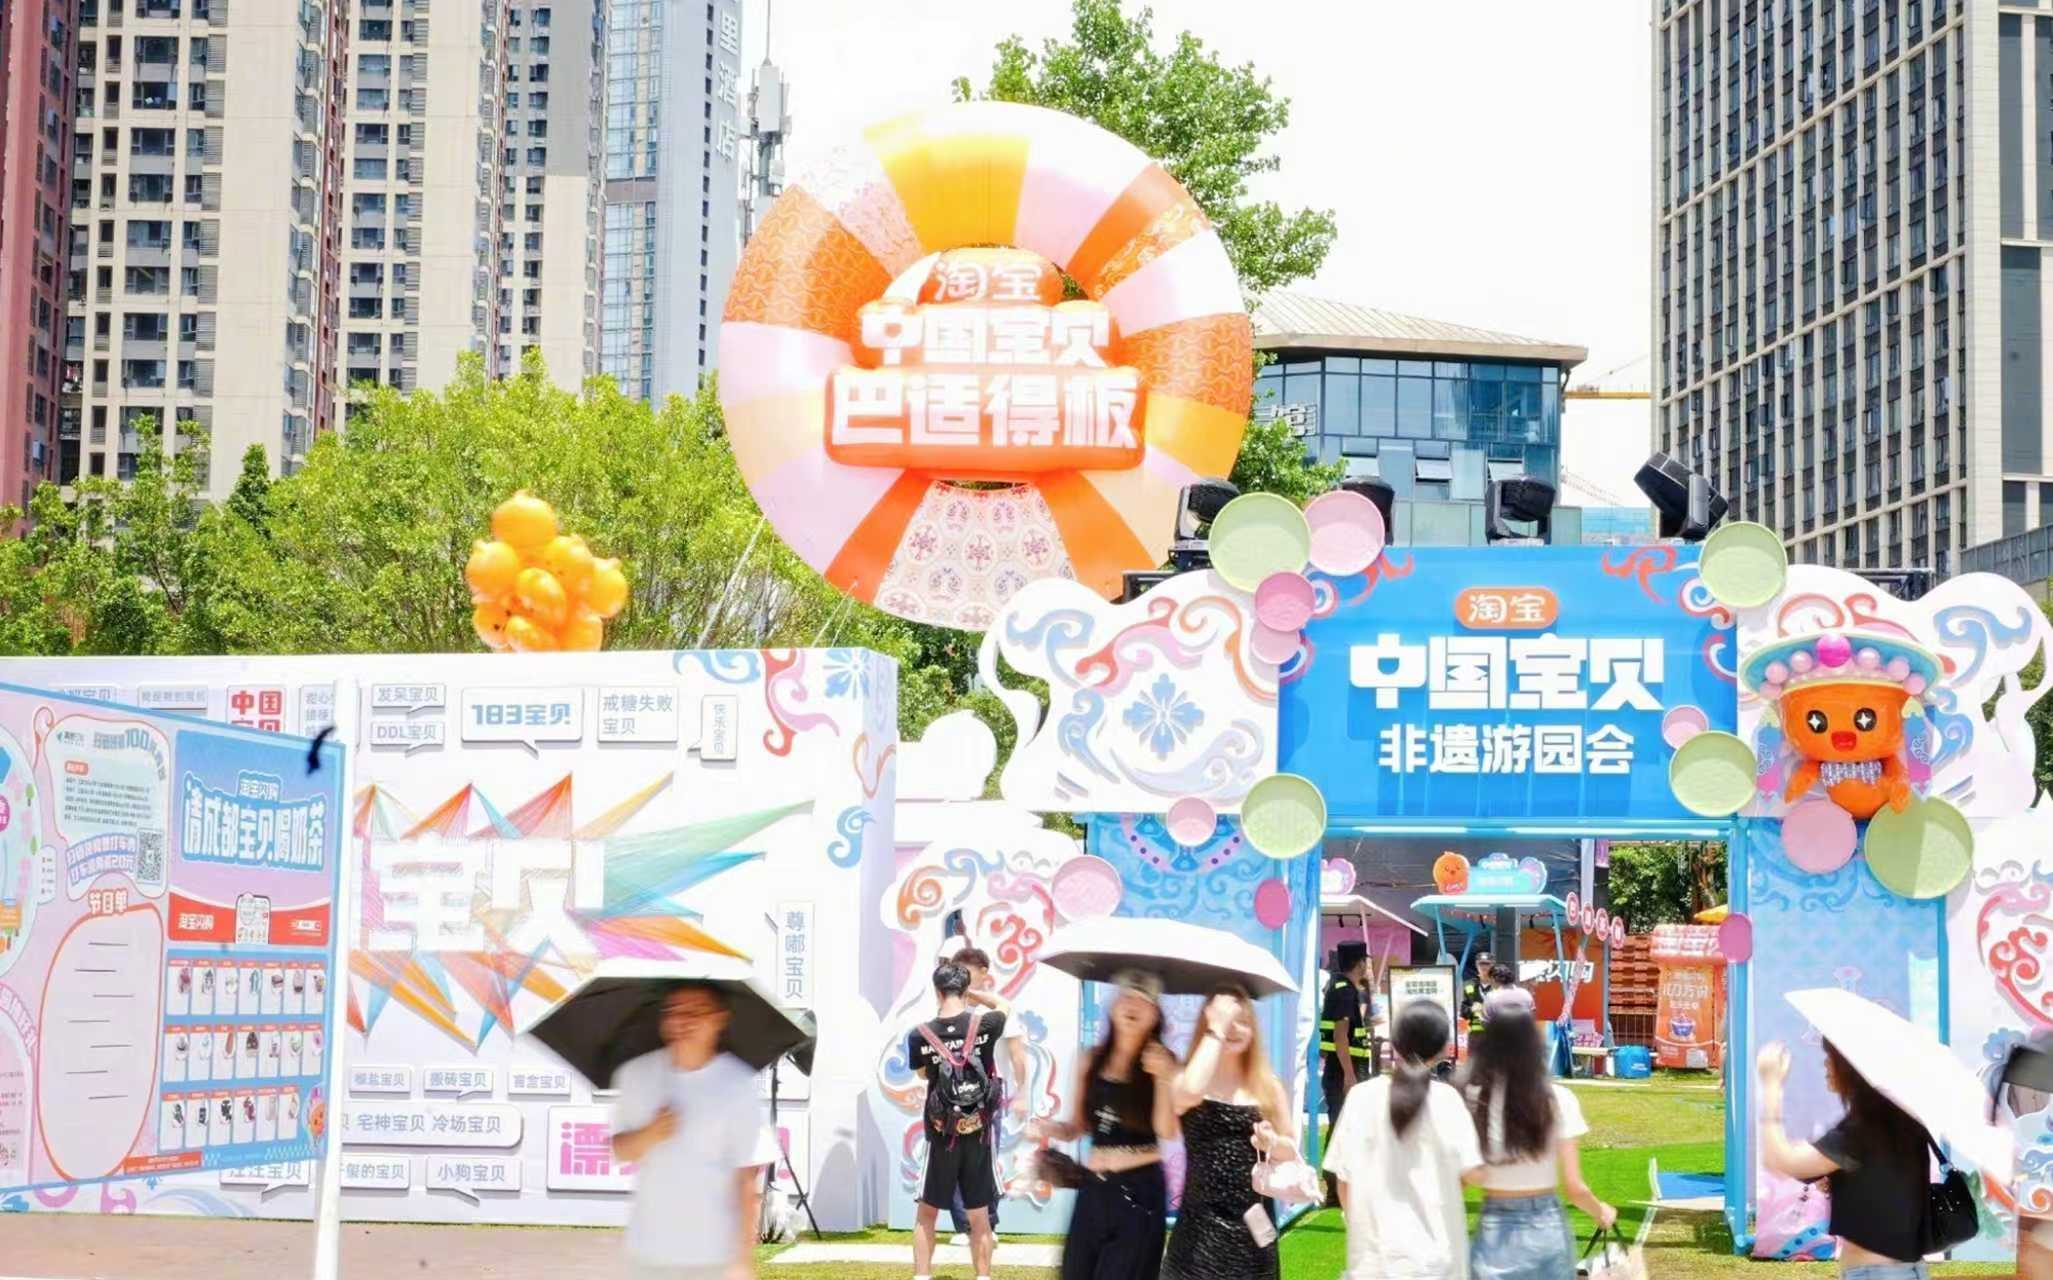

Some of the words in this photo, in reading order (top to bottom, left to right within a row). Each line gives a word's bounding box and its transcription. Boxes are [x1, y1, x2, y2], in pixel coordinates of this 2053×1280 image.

[934, 258, 1043, 302] 淘宝
[860, 303, 1112, 369] 中国宝贝
[832, 371, 1138, 450] 巴适得板
[1467, 593, 1546, 624] 淘宝
[1349, 632, 1665, 711] 中国宝贝
[231, 690, 283, 715] 中国
[471, 702, 572, 727] 183宝贝
[602, 694, 673, 713] 戒糖失败
[376, 725, 437, 741] DDL宝贝
[602, 717, 636, 736] 宝贝
[1378, 723, 1635, 775] 非遗游园会
[784, 911, 805, 1000] 尊嘟宝贝
[357, 1113, 425, 1134] 宅神宝贝
[432, 1115, 502, 1134] 冷场宝贝
[437, 1164, 506, 1183] 小狗宝贝
